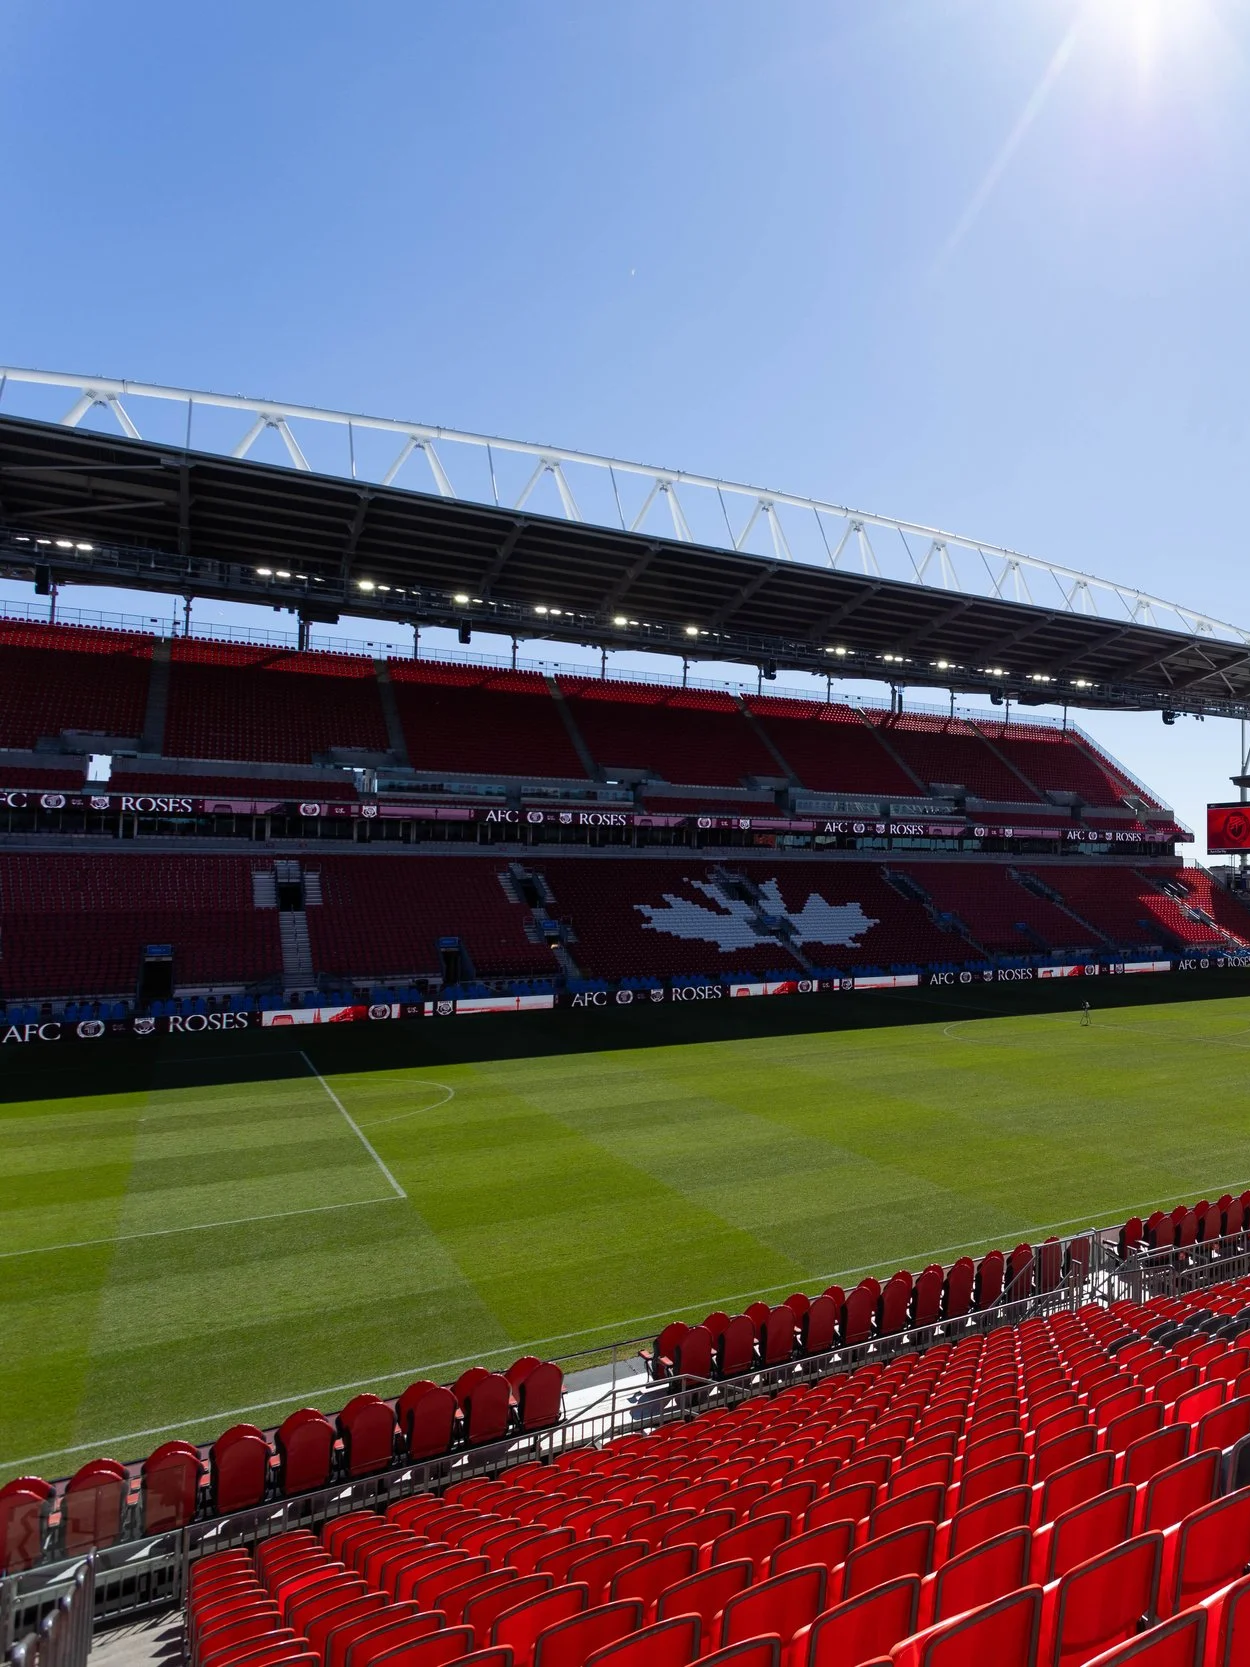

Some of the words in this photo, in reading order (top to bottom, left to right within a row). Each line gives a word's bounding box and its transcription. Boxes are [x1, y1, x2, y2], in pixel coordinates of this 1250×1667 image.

[121, 796, 192, 813] ROSES
[485, 809, 519, 823] AFC
[579, 813, 626, 827] ROSES
[824, 822, 848, 833] AFC
[890, 824, 924, 836] ROSES
[1066, 830, 1085, 840] AFC
[1115, 832, 1142, 842] ROSES
[1178, 959, 1197, 970] AFC
[929, 972, 955, 985] AFC
[998, 968, 1033, 981] ROSES
[571, 991, 607, 1007] AFC
[672, 985, 722, 1001] ROSES
[2, 1022, 62, 1043] AFC
[169, 1011, 248, 1033] ROSES
